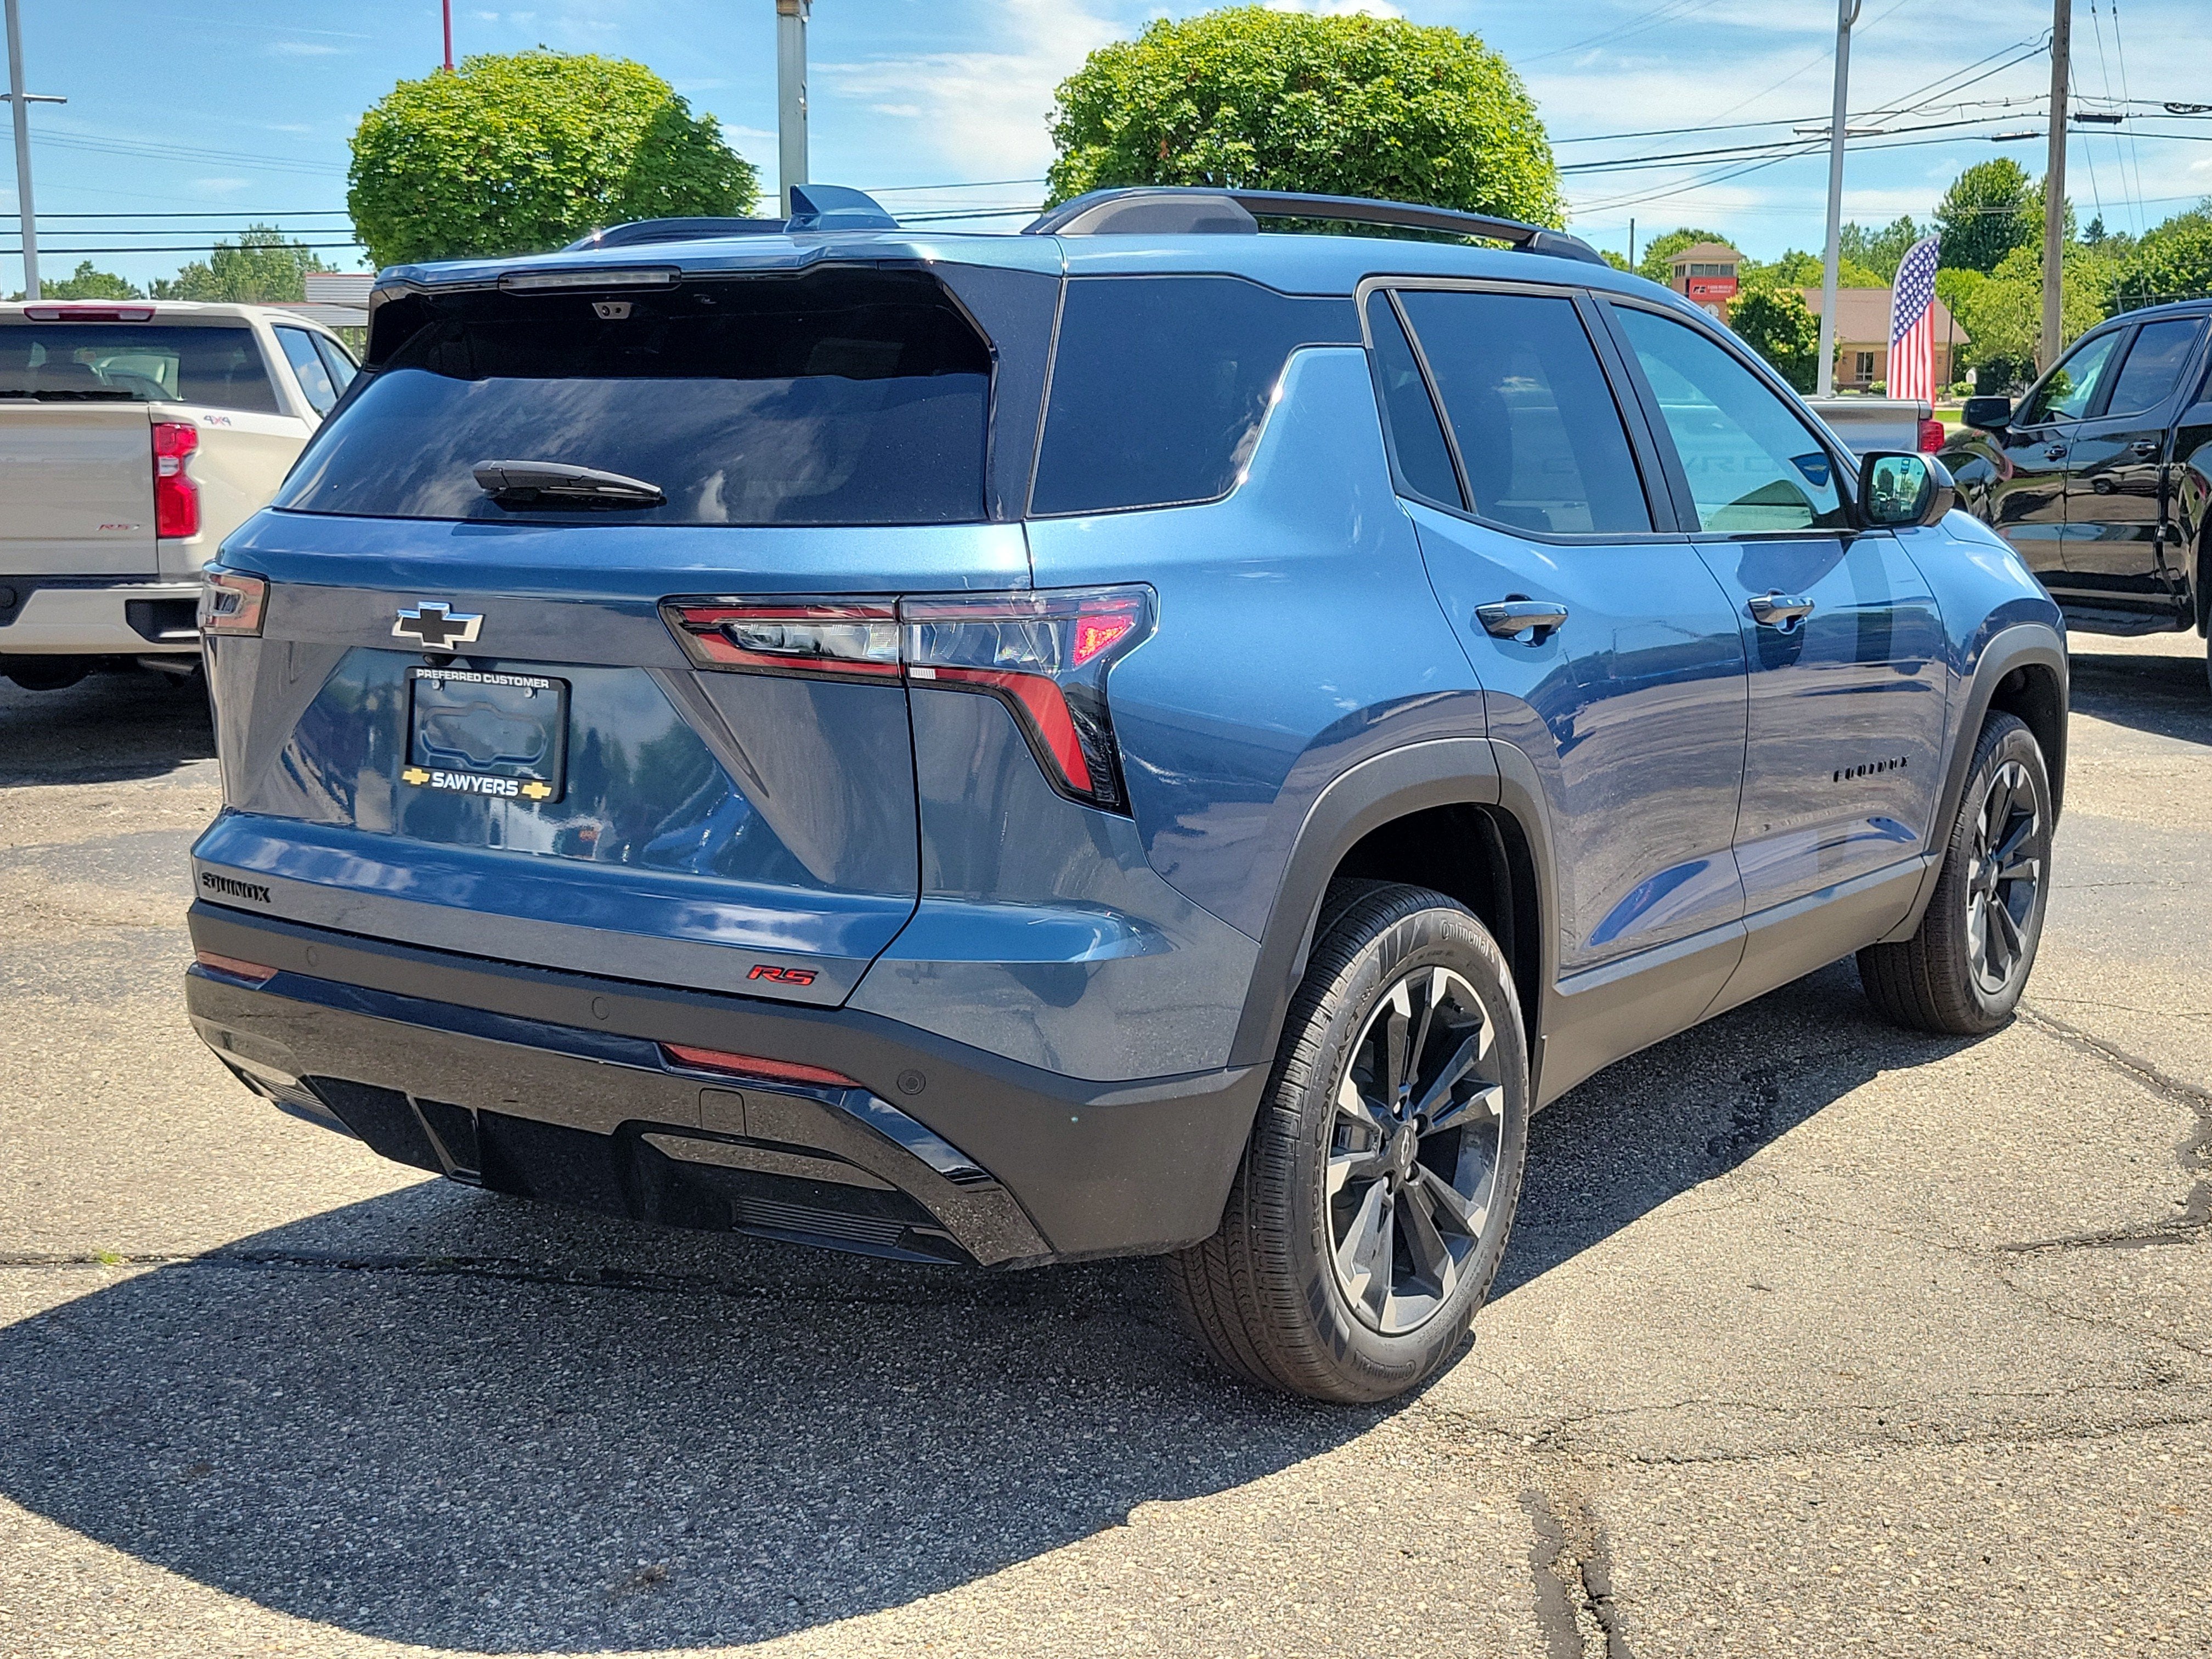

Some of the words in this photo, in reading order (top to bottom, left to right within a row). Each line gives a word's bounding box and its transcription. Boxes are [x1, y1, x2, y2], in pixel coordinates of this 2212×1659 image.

[416, 669, 482, 682] PREFERRED
[483, 674, 550, 689] CUSTOMER
[431, 771, 519, 796] SAWYERS
[202, 871, 272, 903] EQUINOX
[746, 964, 819, 986] RS
